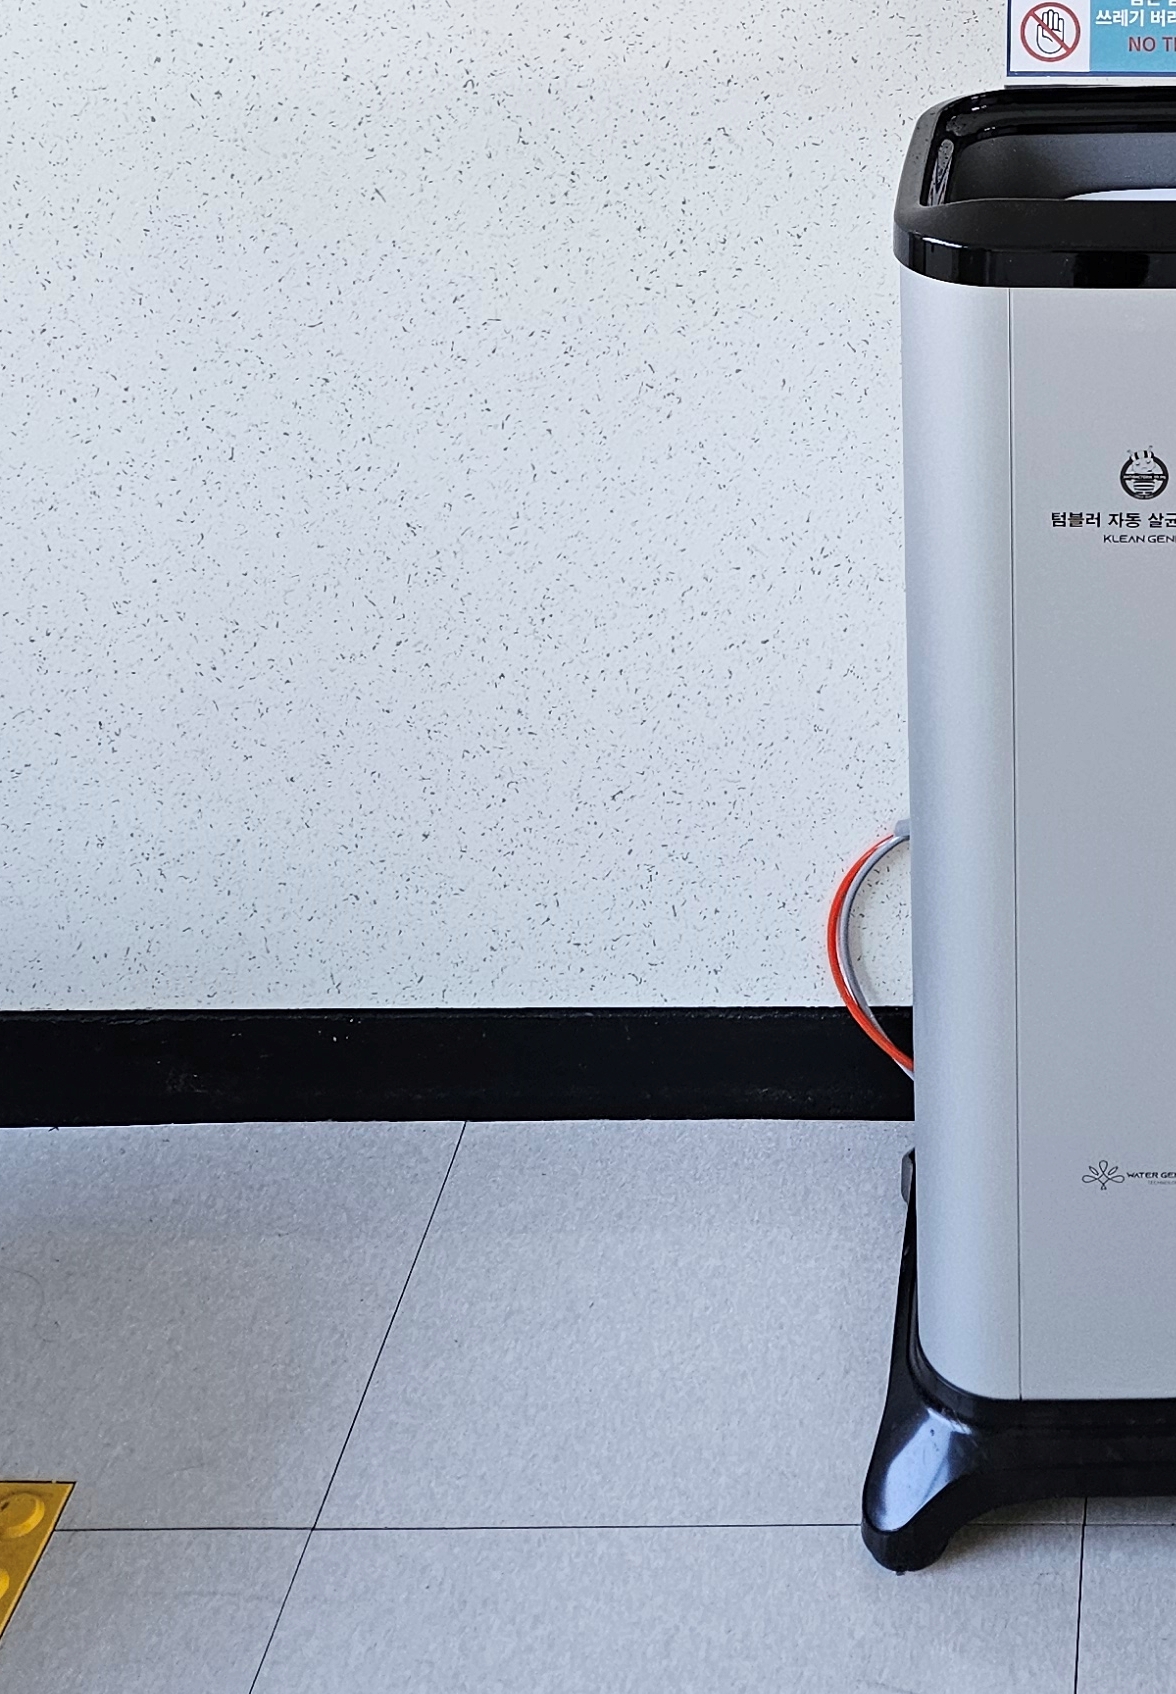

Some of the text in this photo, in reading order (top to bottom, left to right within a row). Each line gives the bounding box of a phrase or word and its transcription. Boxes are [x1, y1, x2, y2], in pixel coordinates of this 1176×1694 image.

[1096, 9, 1144, 27] 쓰레기
[1128, 37, 1156, 52] NO
[1051, 512, 1101, 528] 텀블러
[1108, 512, 1142, 528] 자동
[1104, 534, 1145, 544] KLEAN
[1126, 1171, 1159, 1179] WATER
